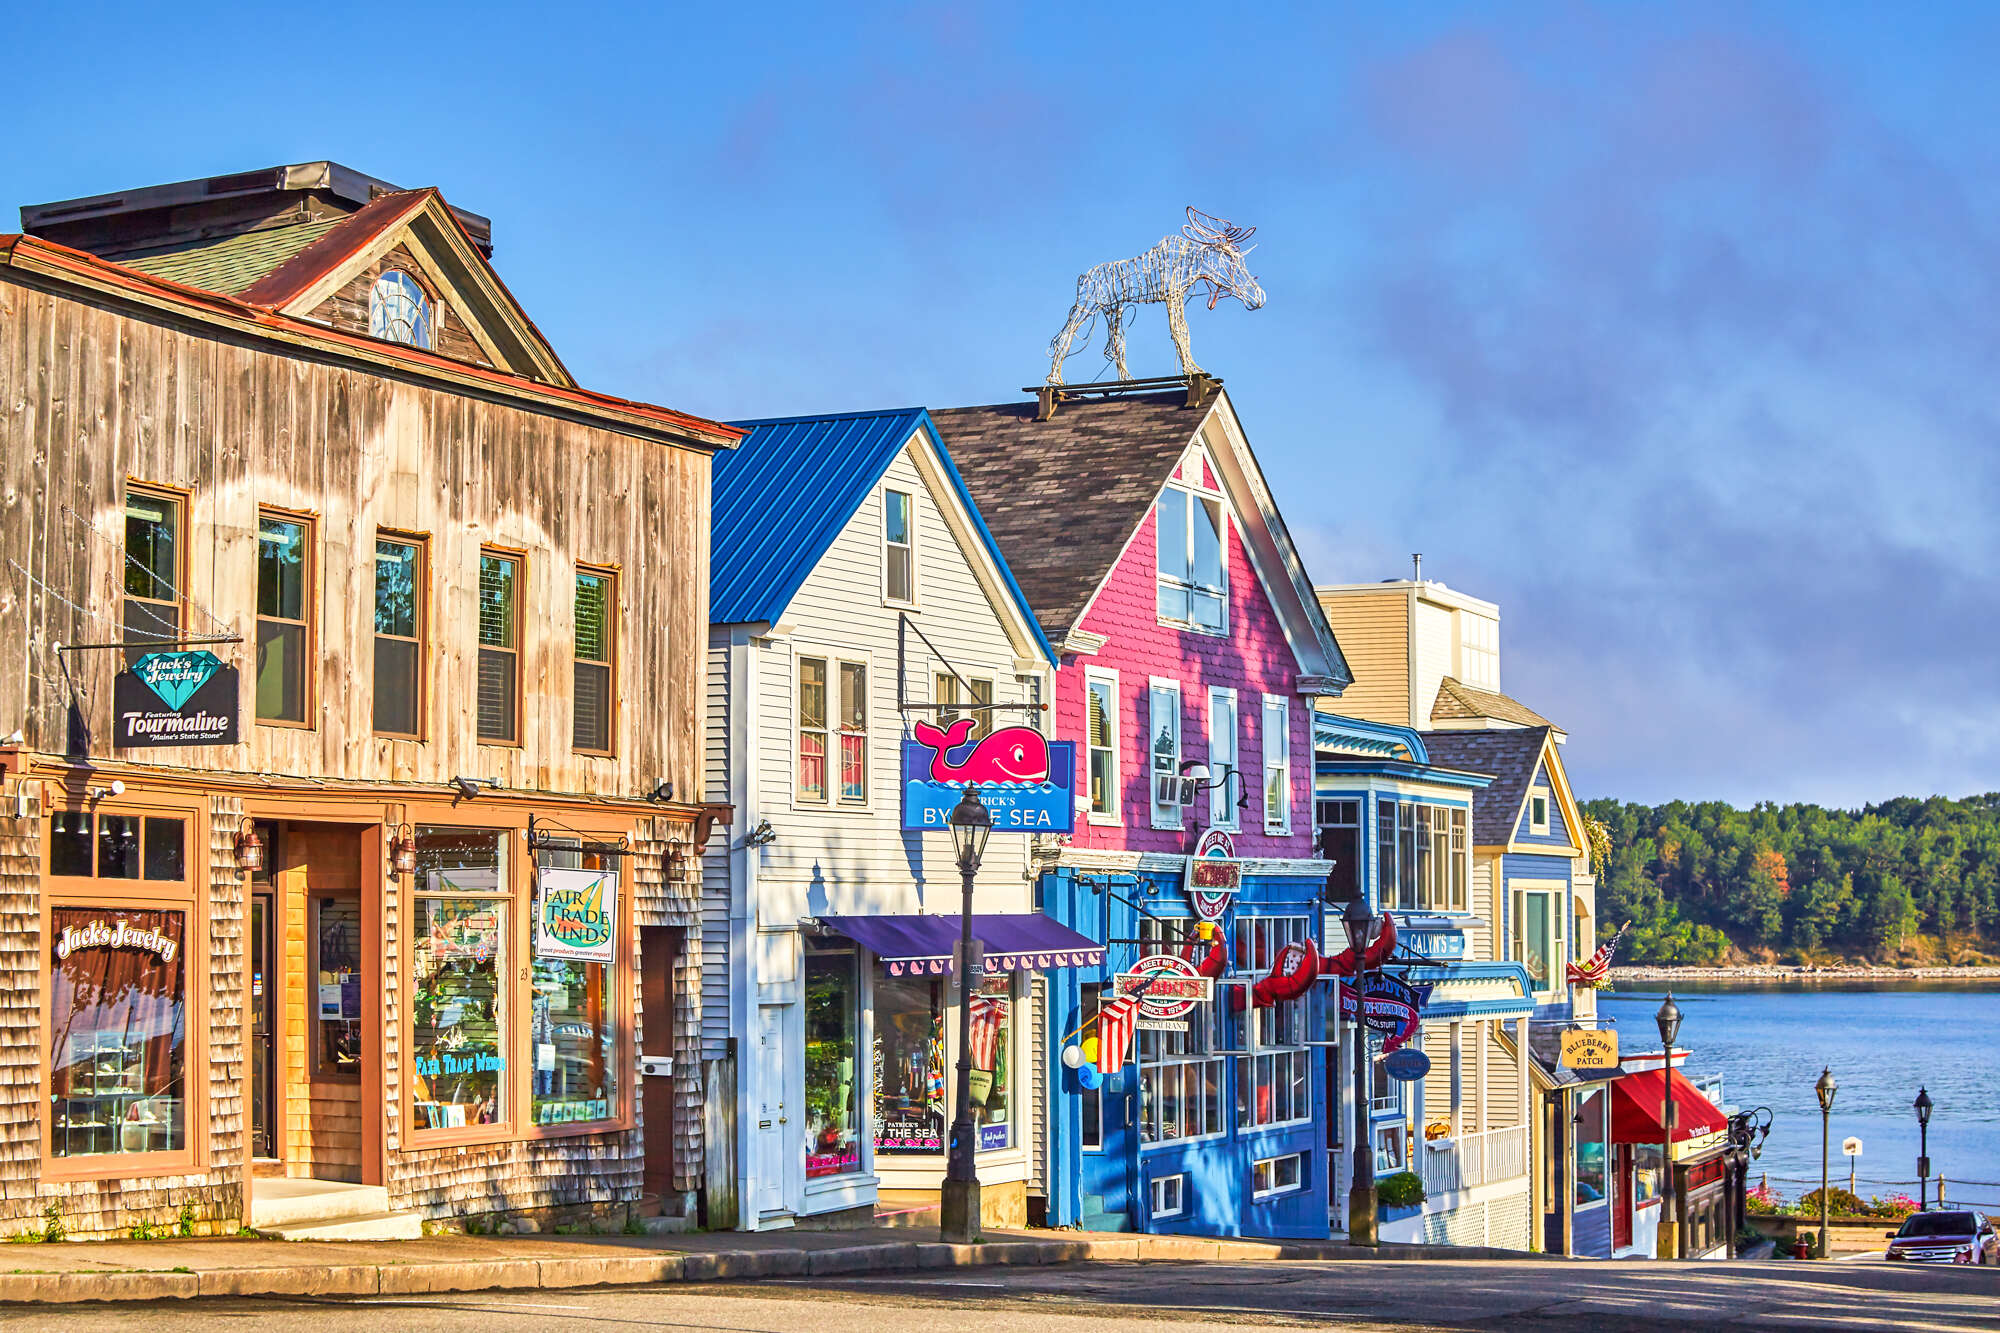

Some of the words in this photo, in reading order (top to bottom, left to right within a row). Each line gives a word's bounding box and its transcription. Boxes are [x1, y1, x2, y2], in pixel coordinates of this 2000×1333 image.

[147, 658, 192, 672] Jack's
[147, 669, 204, 683] Jewelry
[123, 710, 229, 736] Tourmaline
[1010, 809, 1051, 826] SEA
[544, 887, 584, 905] FAIR
[547, 905, 609, 925] TRADE
[542, 922, 609, 943] WINDS
[57, 920, 111, 959] Jack's
[110, 919, 177, 962] Jewelry
[1411, 934, 1447, 954] GALYN'S
[1140, 960, 1160, 970] MEET
[1162, 959, 1174, 967] ME
[1175, 962, 1186, 972] AT
[520, 967, 528, 981] 23
[1141, 1003, 1164, 1015] SINCE
[1167, 1005, 1184, 1014] 1974
[1136, 1021, 1187, 1030] RESTAURANT
[1367, 1017, 1379, 1028] COOL
[1566, 1039, 1613, 1055] BLUEBERRY
[443, 1054, 473, 1074] TRADE
[1577, 1057, 1604, 1065] PATCH
[888, 1128, 911, 1138] THE
[914, 1128, 938, 1138] SEA
